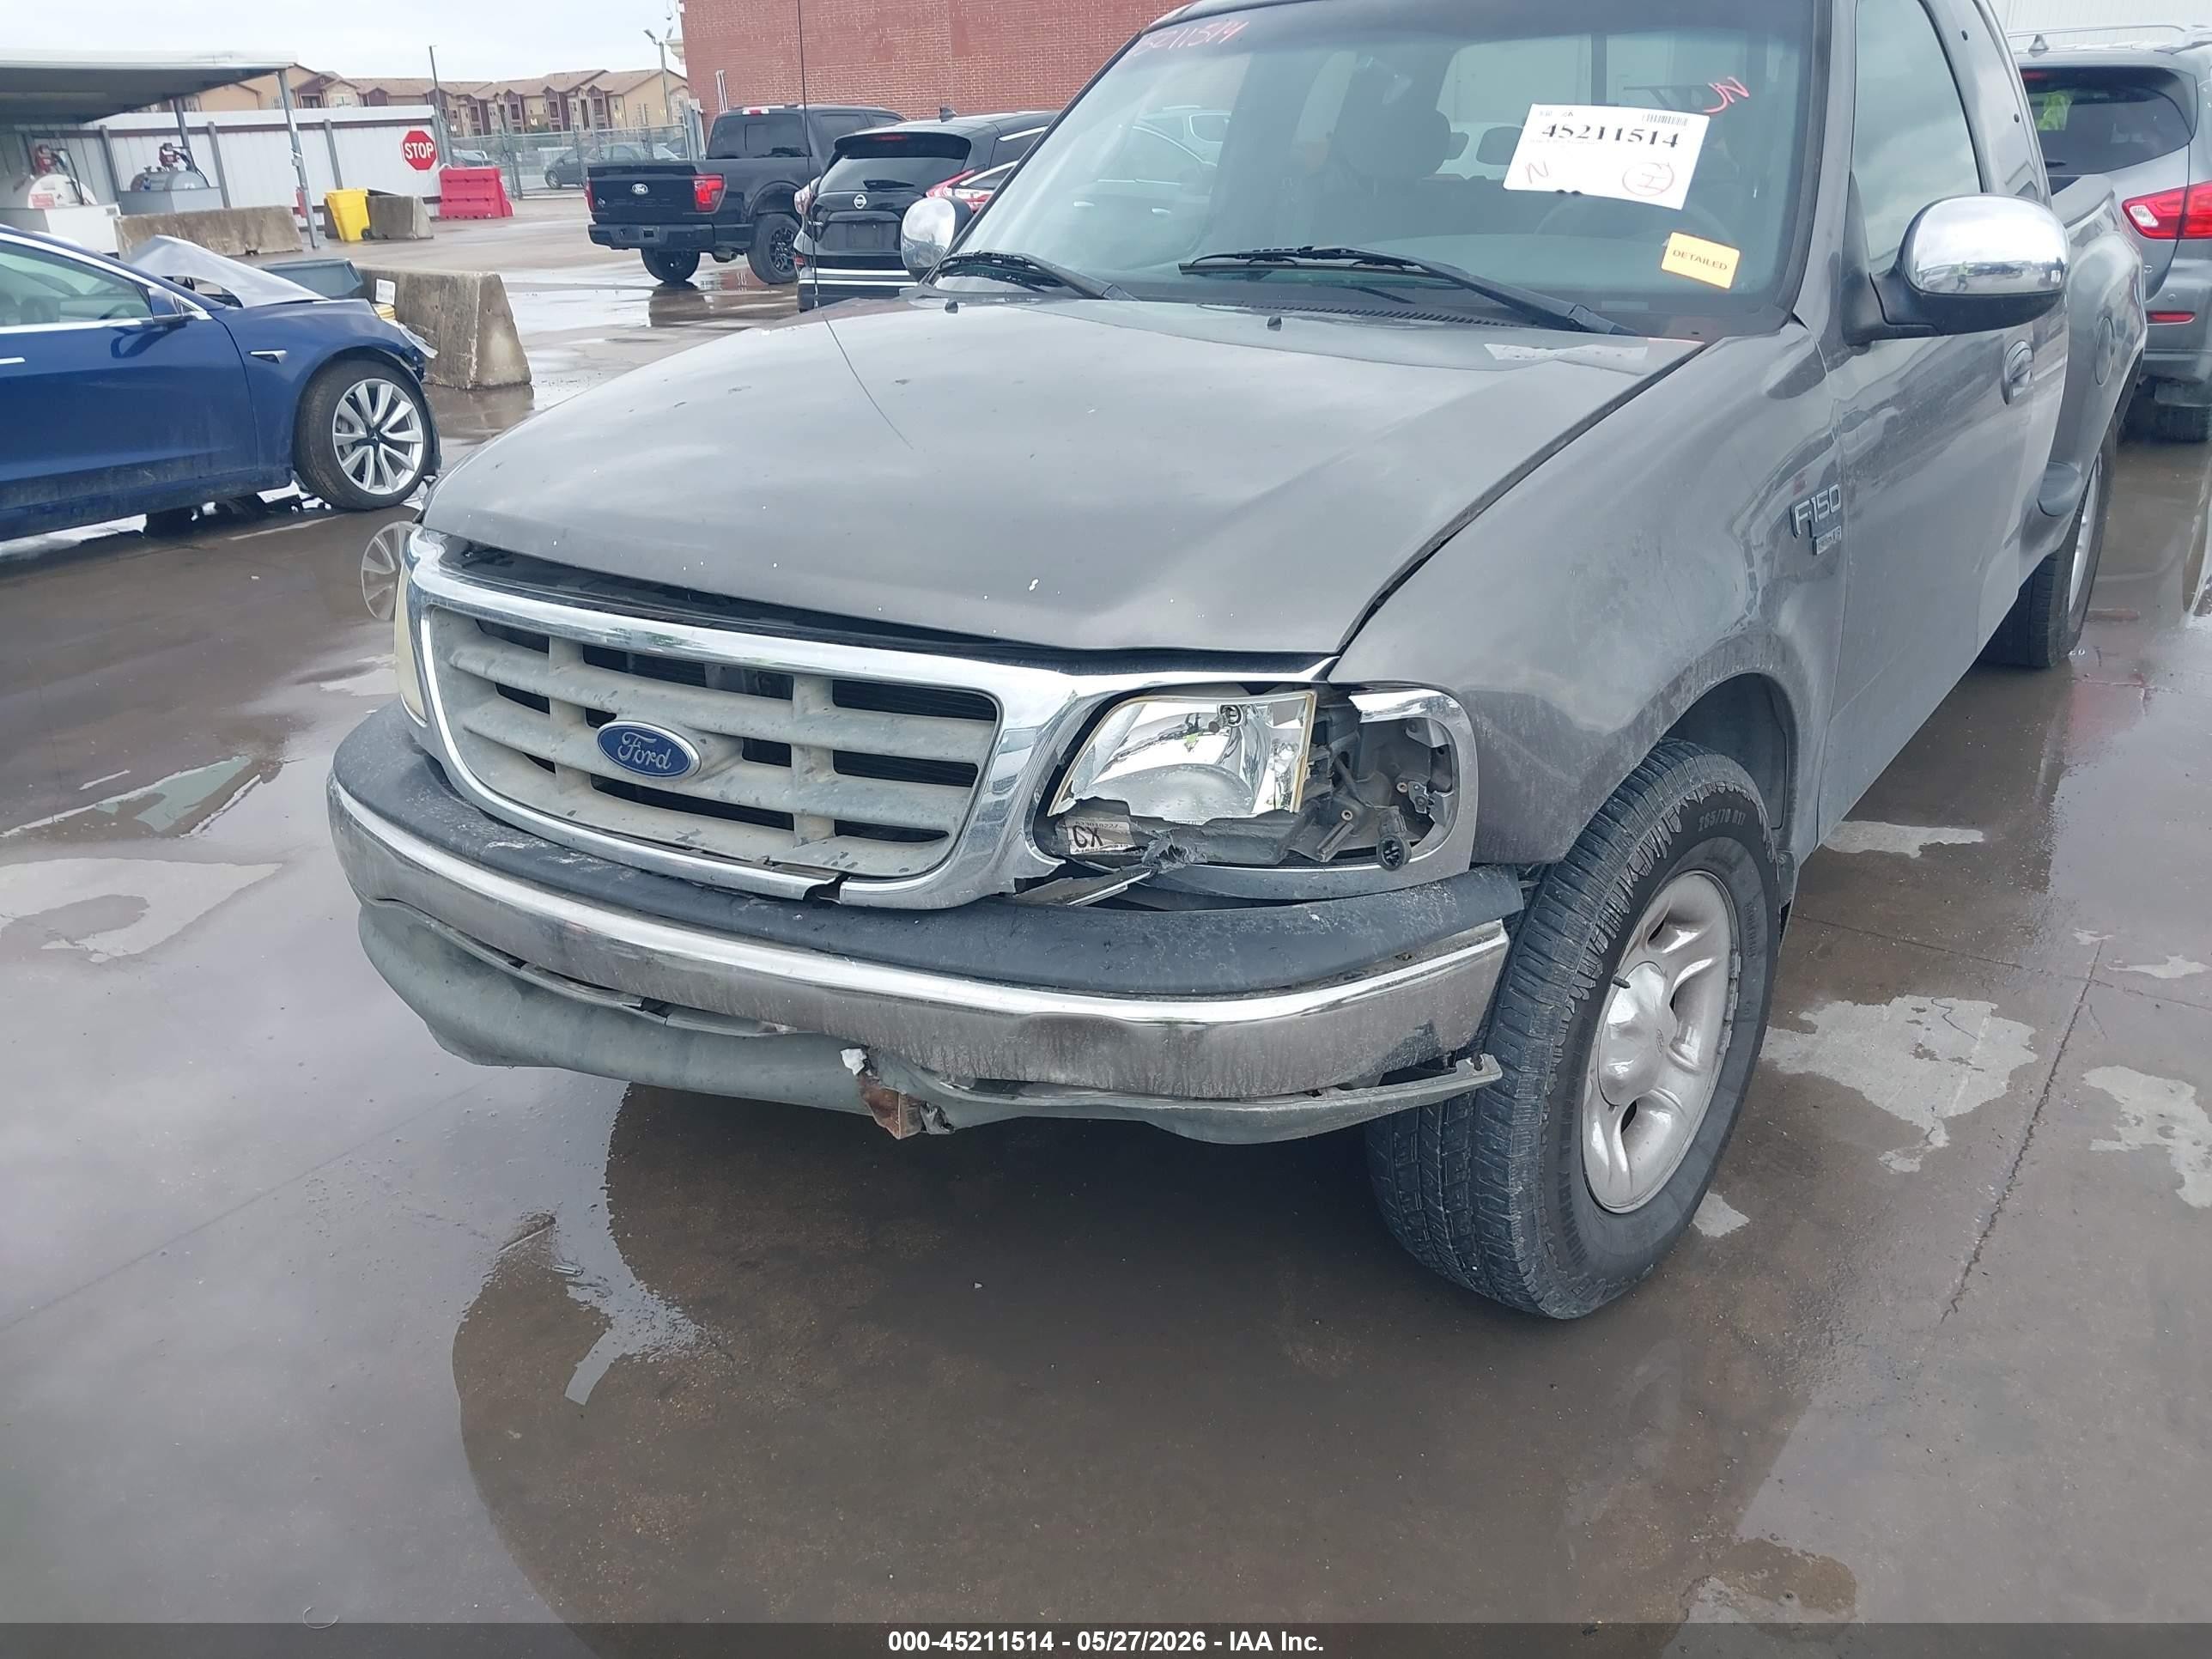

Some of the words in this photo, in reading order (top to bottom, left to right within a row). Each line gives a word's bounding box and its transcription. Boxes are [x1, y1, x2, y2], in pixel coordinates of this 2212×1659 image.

[1542, 123, 1679, 148] 45211514
[404, 142, 434, 160] STOP
[1672, 249, 1729, 270] DETAILED
[617, 731, 672, 770] Ford
